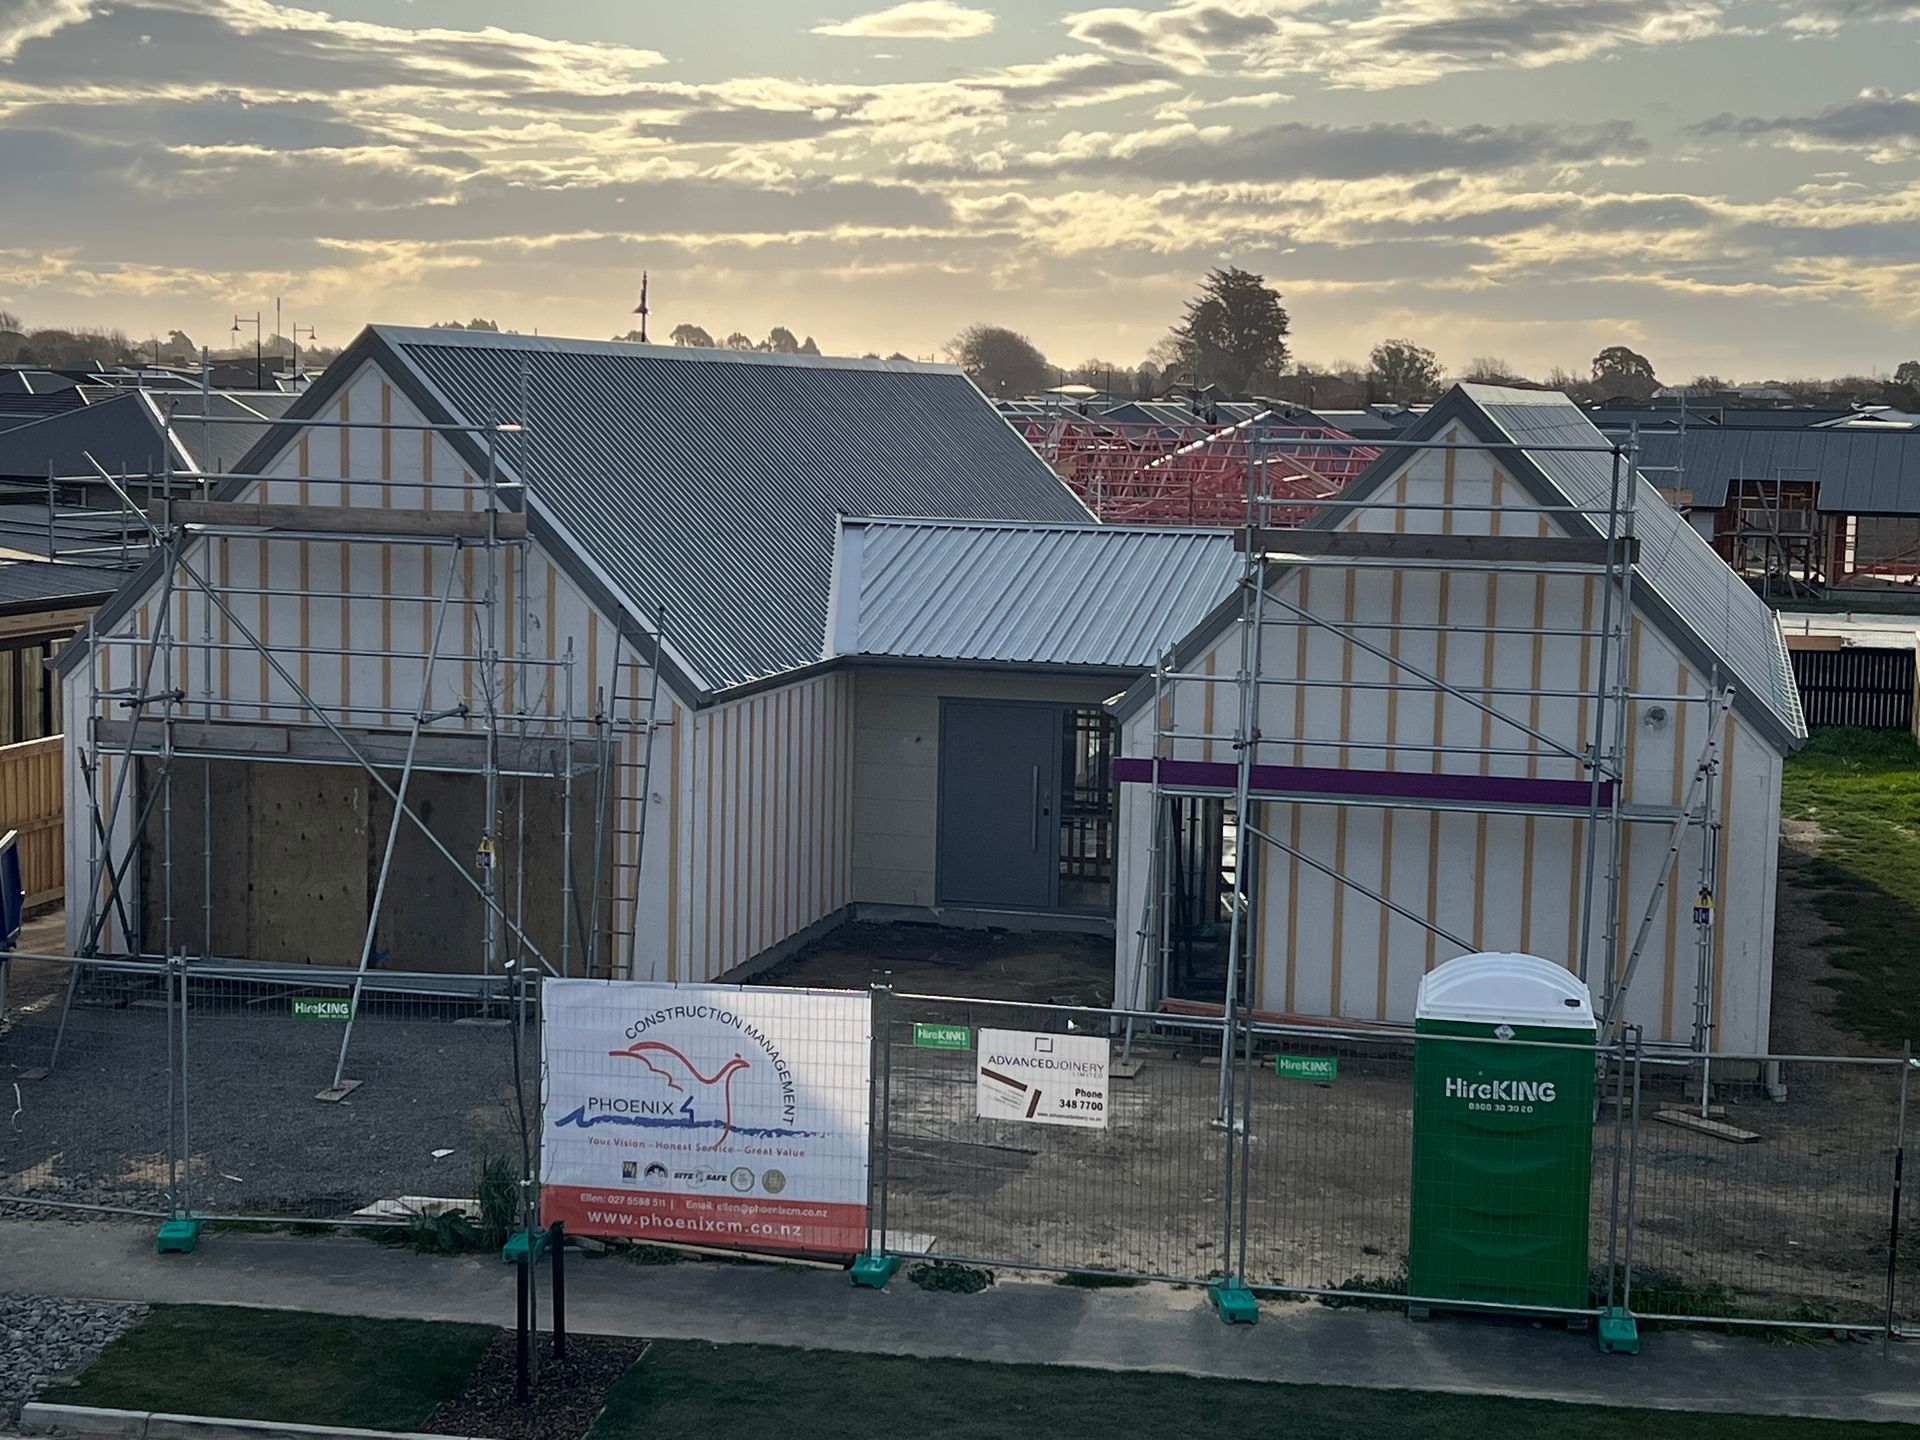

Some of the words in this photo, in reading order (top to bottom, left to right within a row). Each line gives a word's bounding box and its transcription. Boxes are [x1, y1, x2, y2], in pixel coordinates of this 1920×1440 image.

[295, 1002, 349, 1015] HireKING
[625, 1005, 743, 1040] CONSTRUCTION
[744, 1024, 797, 1127] MANAGEMENT
[1075, 1088, 1103, 1099] Phone
[1445, 1077, 1557, 1102] HireKING
[588, 1096, 674, 1115] PHOENIX
[1059, 1099, 1077, 1109] 348
[1080, 1101, 1103, 1111] 7700
[588, 1137, 611, 1145] Your
[613, 1138, 645, 1148] Vision
[655, 1142, 692, 1151] Honest
[696, 1143, 734, 1153] Service
[744, 1146, 773, 1156] Great
[775, 1148, 805, 1157] Value
[674, 1172, 694, 1180] SITE
[706, 1174, 728, 1182] SAFE
[607, 1195, 624, 1205] 027
[587, 1211, 802, 1236] www.phoenixcm.co.nz
